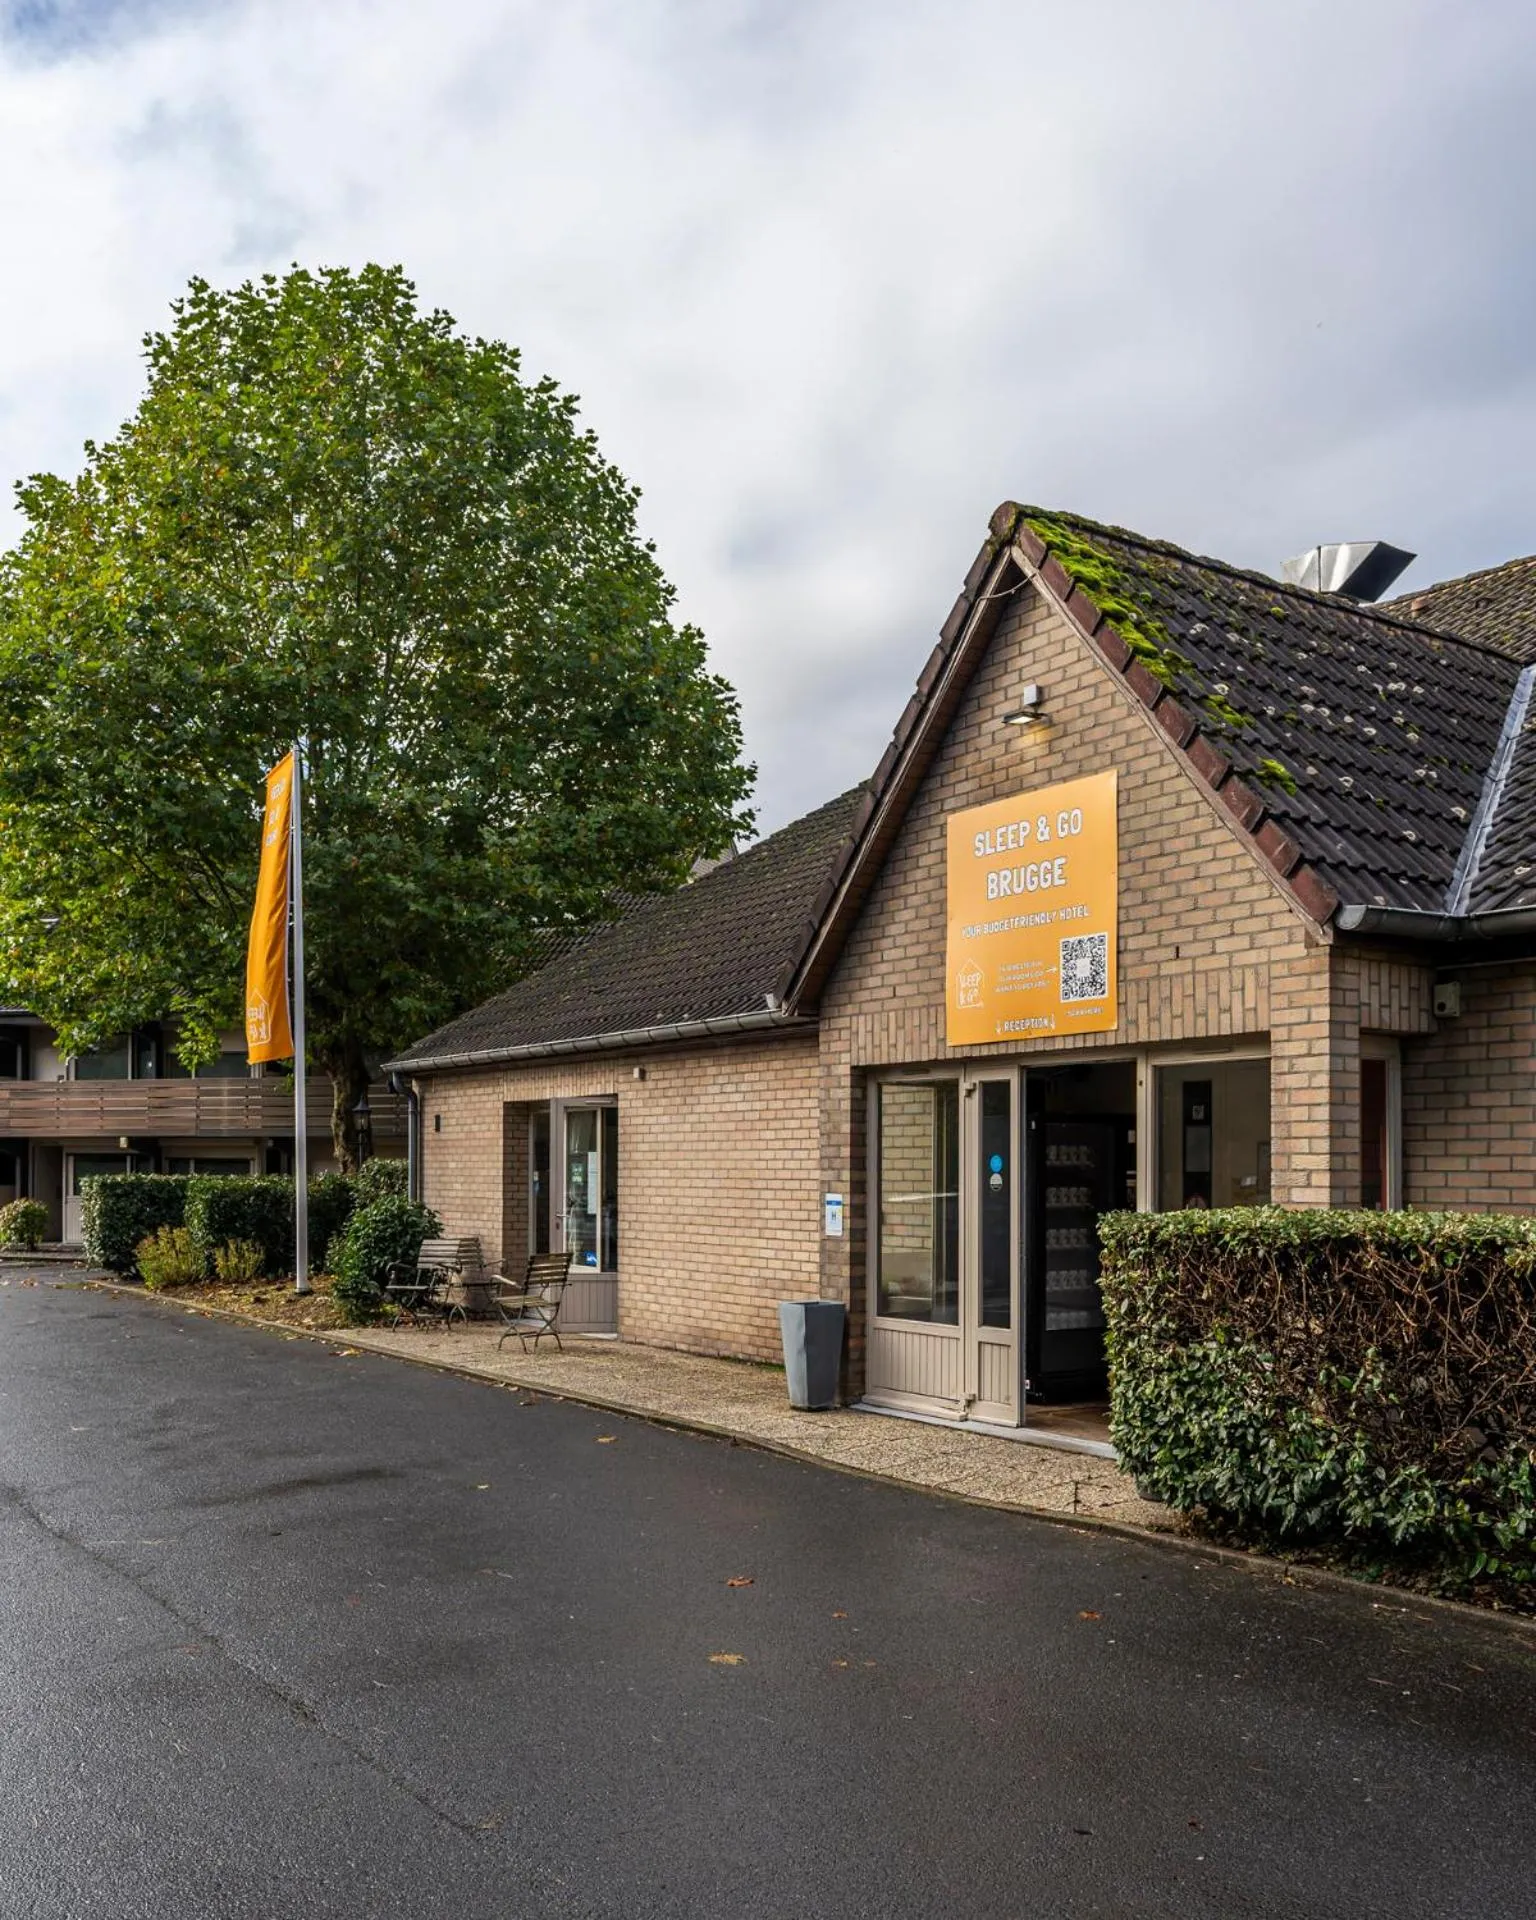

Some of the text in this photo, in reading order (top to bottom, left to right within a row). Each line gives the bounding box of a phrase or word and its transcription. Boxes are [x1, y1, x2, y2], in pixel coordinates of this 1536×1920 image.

[974, 808, 1082, 857] SLEEP & GO
[987, 856, 1067, 901] BRUGGE
[962, 924, 982, 938] YOUR
[1060, 904, 1089, 920] HOTEL
[1004, 1017, 1048, 1033] RECEPTION
